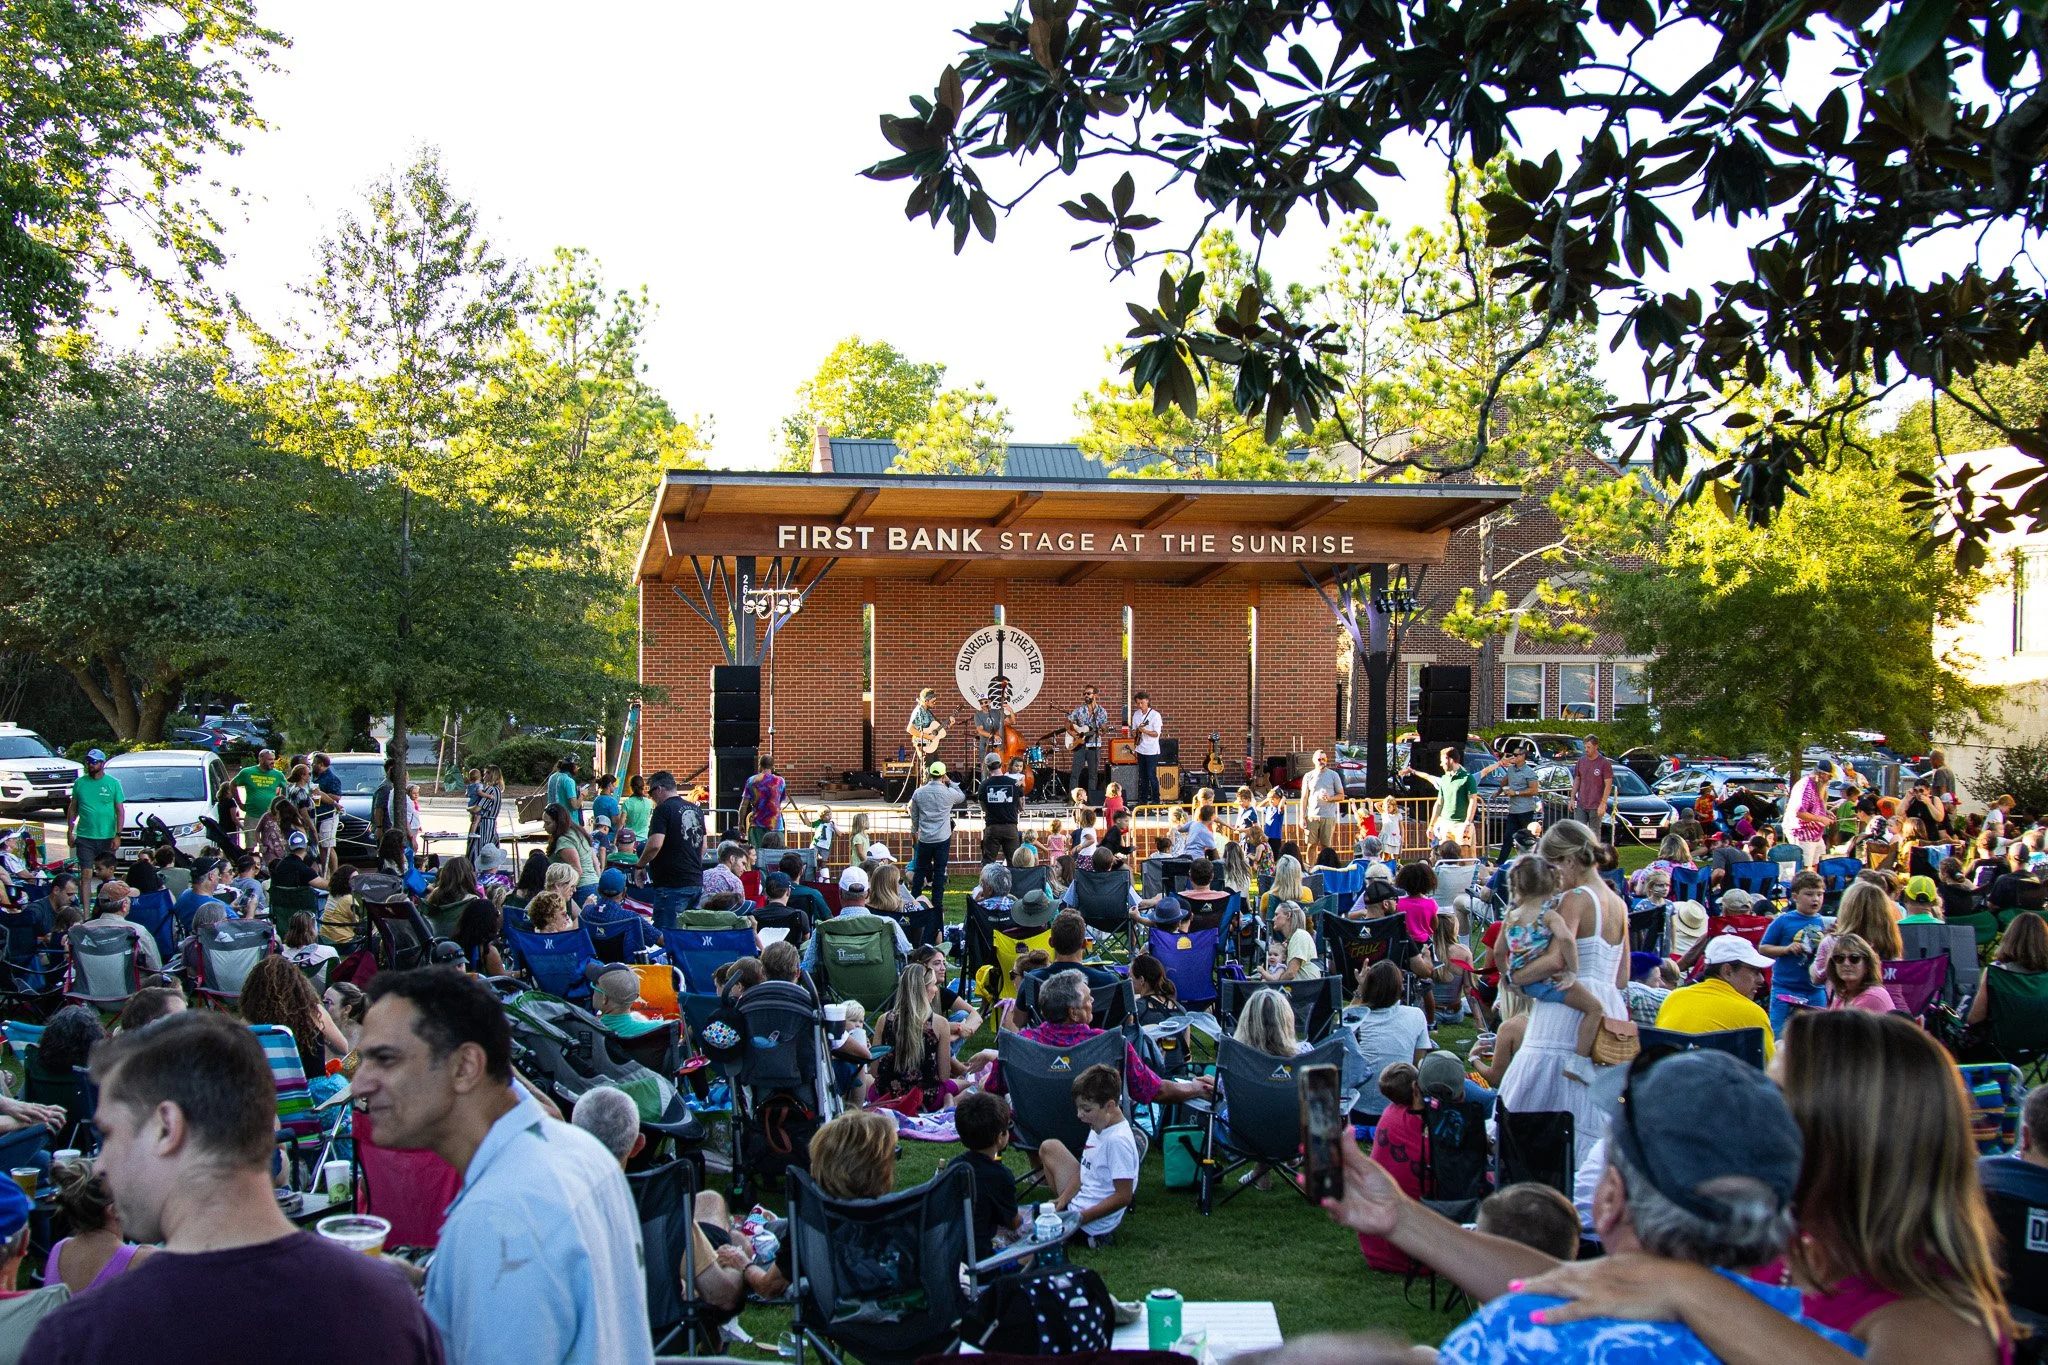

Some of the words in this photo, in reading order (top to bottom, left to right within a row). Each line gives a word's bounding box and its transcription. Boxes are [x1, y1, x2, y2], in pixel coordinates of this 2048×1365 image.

[778, 525, 875, 550] FIRST
[888, 527, 983, 552] BANK
[999, 532, 1095, 552] STAGE
[1110, 533, 1145, 552] AT
[1161, 534, 1216, 553] THE
[1231, 535, 1355, 554] SUNRISE
[959, 631, 993, 671] SUNRISE
[1009, 631, 1041, 674] THEATER
[983, 662, 997, 670] EST.
